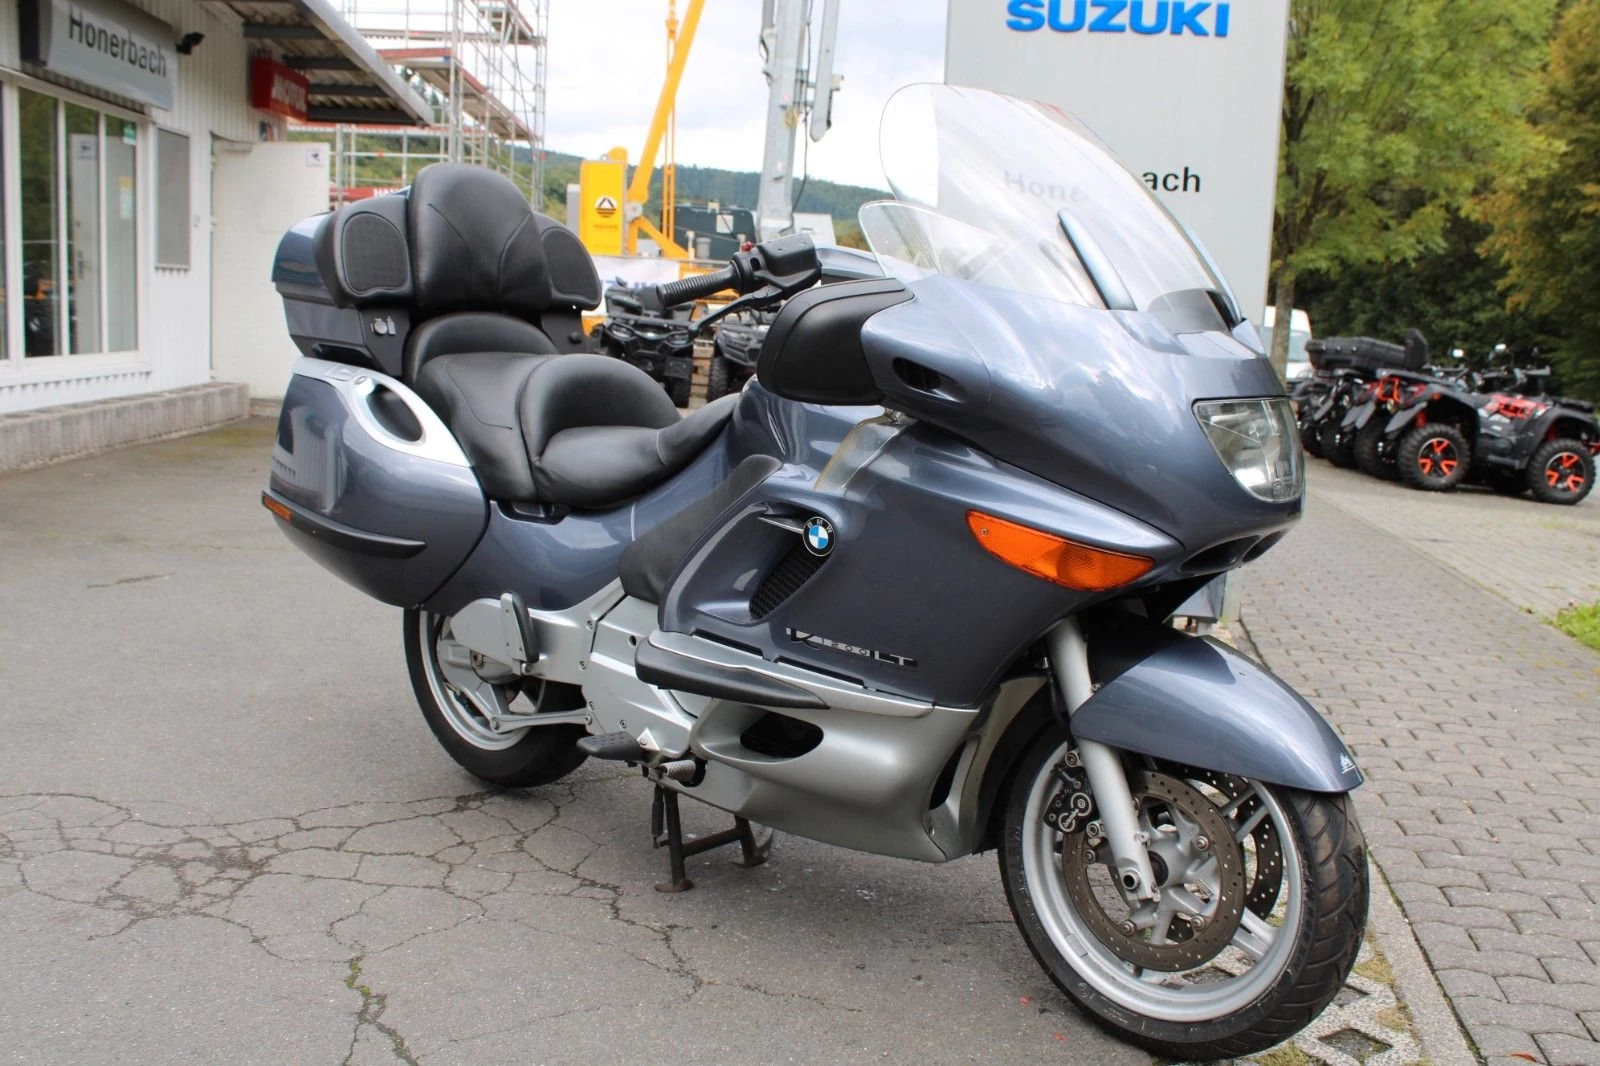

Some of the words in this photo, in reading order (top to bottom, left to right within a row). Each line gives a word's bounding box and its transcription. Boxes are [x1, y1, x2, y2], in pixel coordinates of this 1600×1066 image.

[1006, 0, 1230, 37] SUZUKI
[68, 13, 167, 78] Honerbach
[1003, 166, 1201, 204] Honeach
[806, 518, 833, 534] BMW
